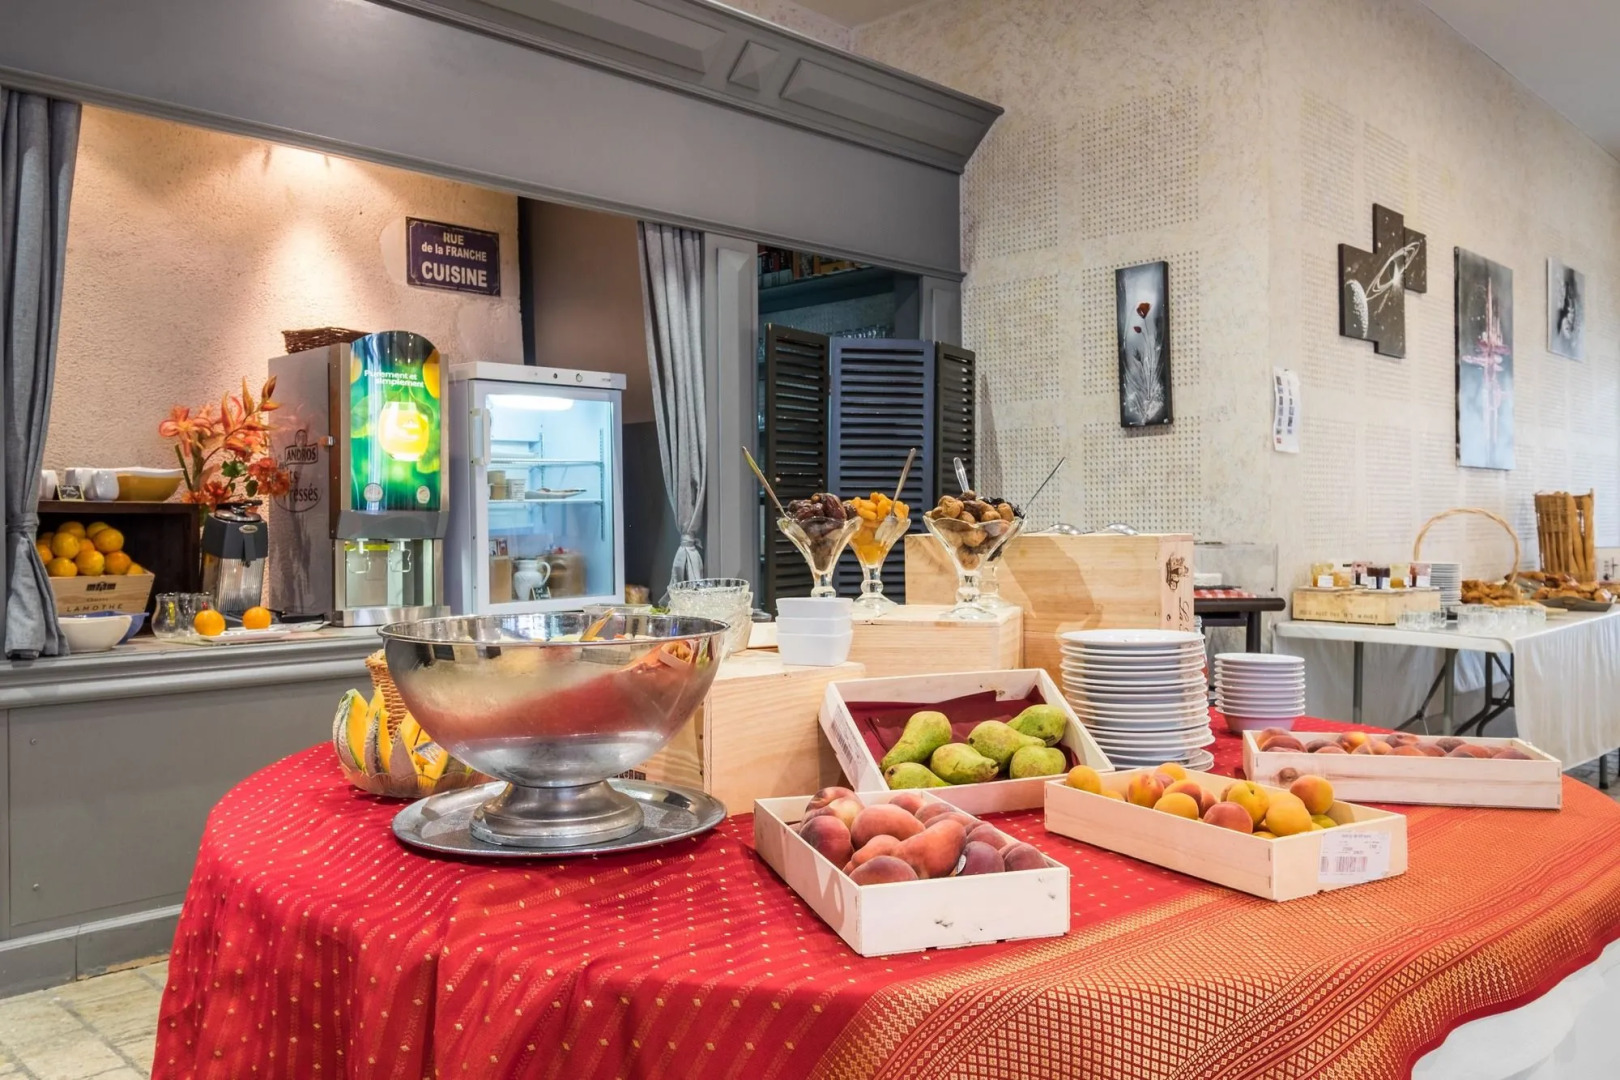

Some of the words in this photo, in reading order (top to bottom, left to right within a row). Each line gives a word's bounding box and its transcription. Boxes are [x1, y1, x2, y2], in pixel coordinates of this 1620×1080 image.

[443, 232, 464, 245] RUE
[421, 241, 433, 253] de
[435, 243, 443, 255] la
[445, 245, 487, 262] FRANCHE
[421, 261, 488, 287] CUISINE
[364, 370, 408, 379] Purement
[375, 378, 424, 388] simplement
[287, 447, 316, 461] ANDROS
[284, 483, 318, 503] ressés
[66, 603, 123, 613] LAMOTHE
